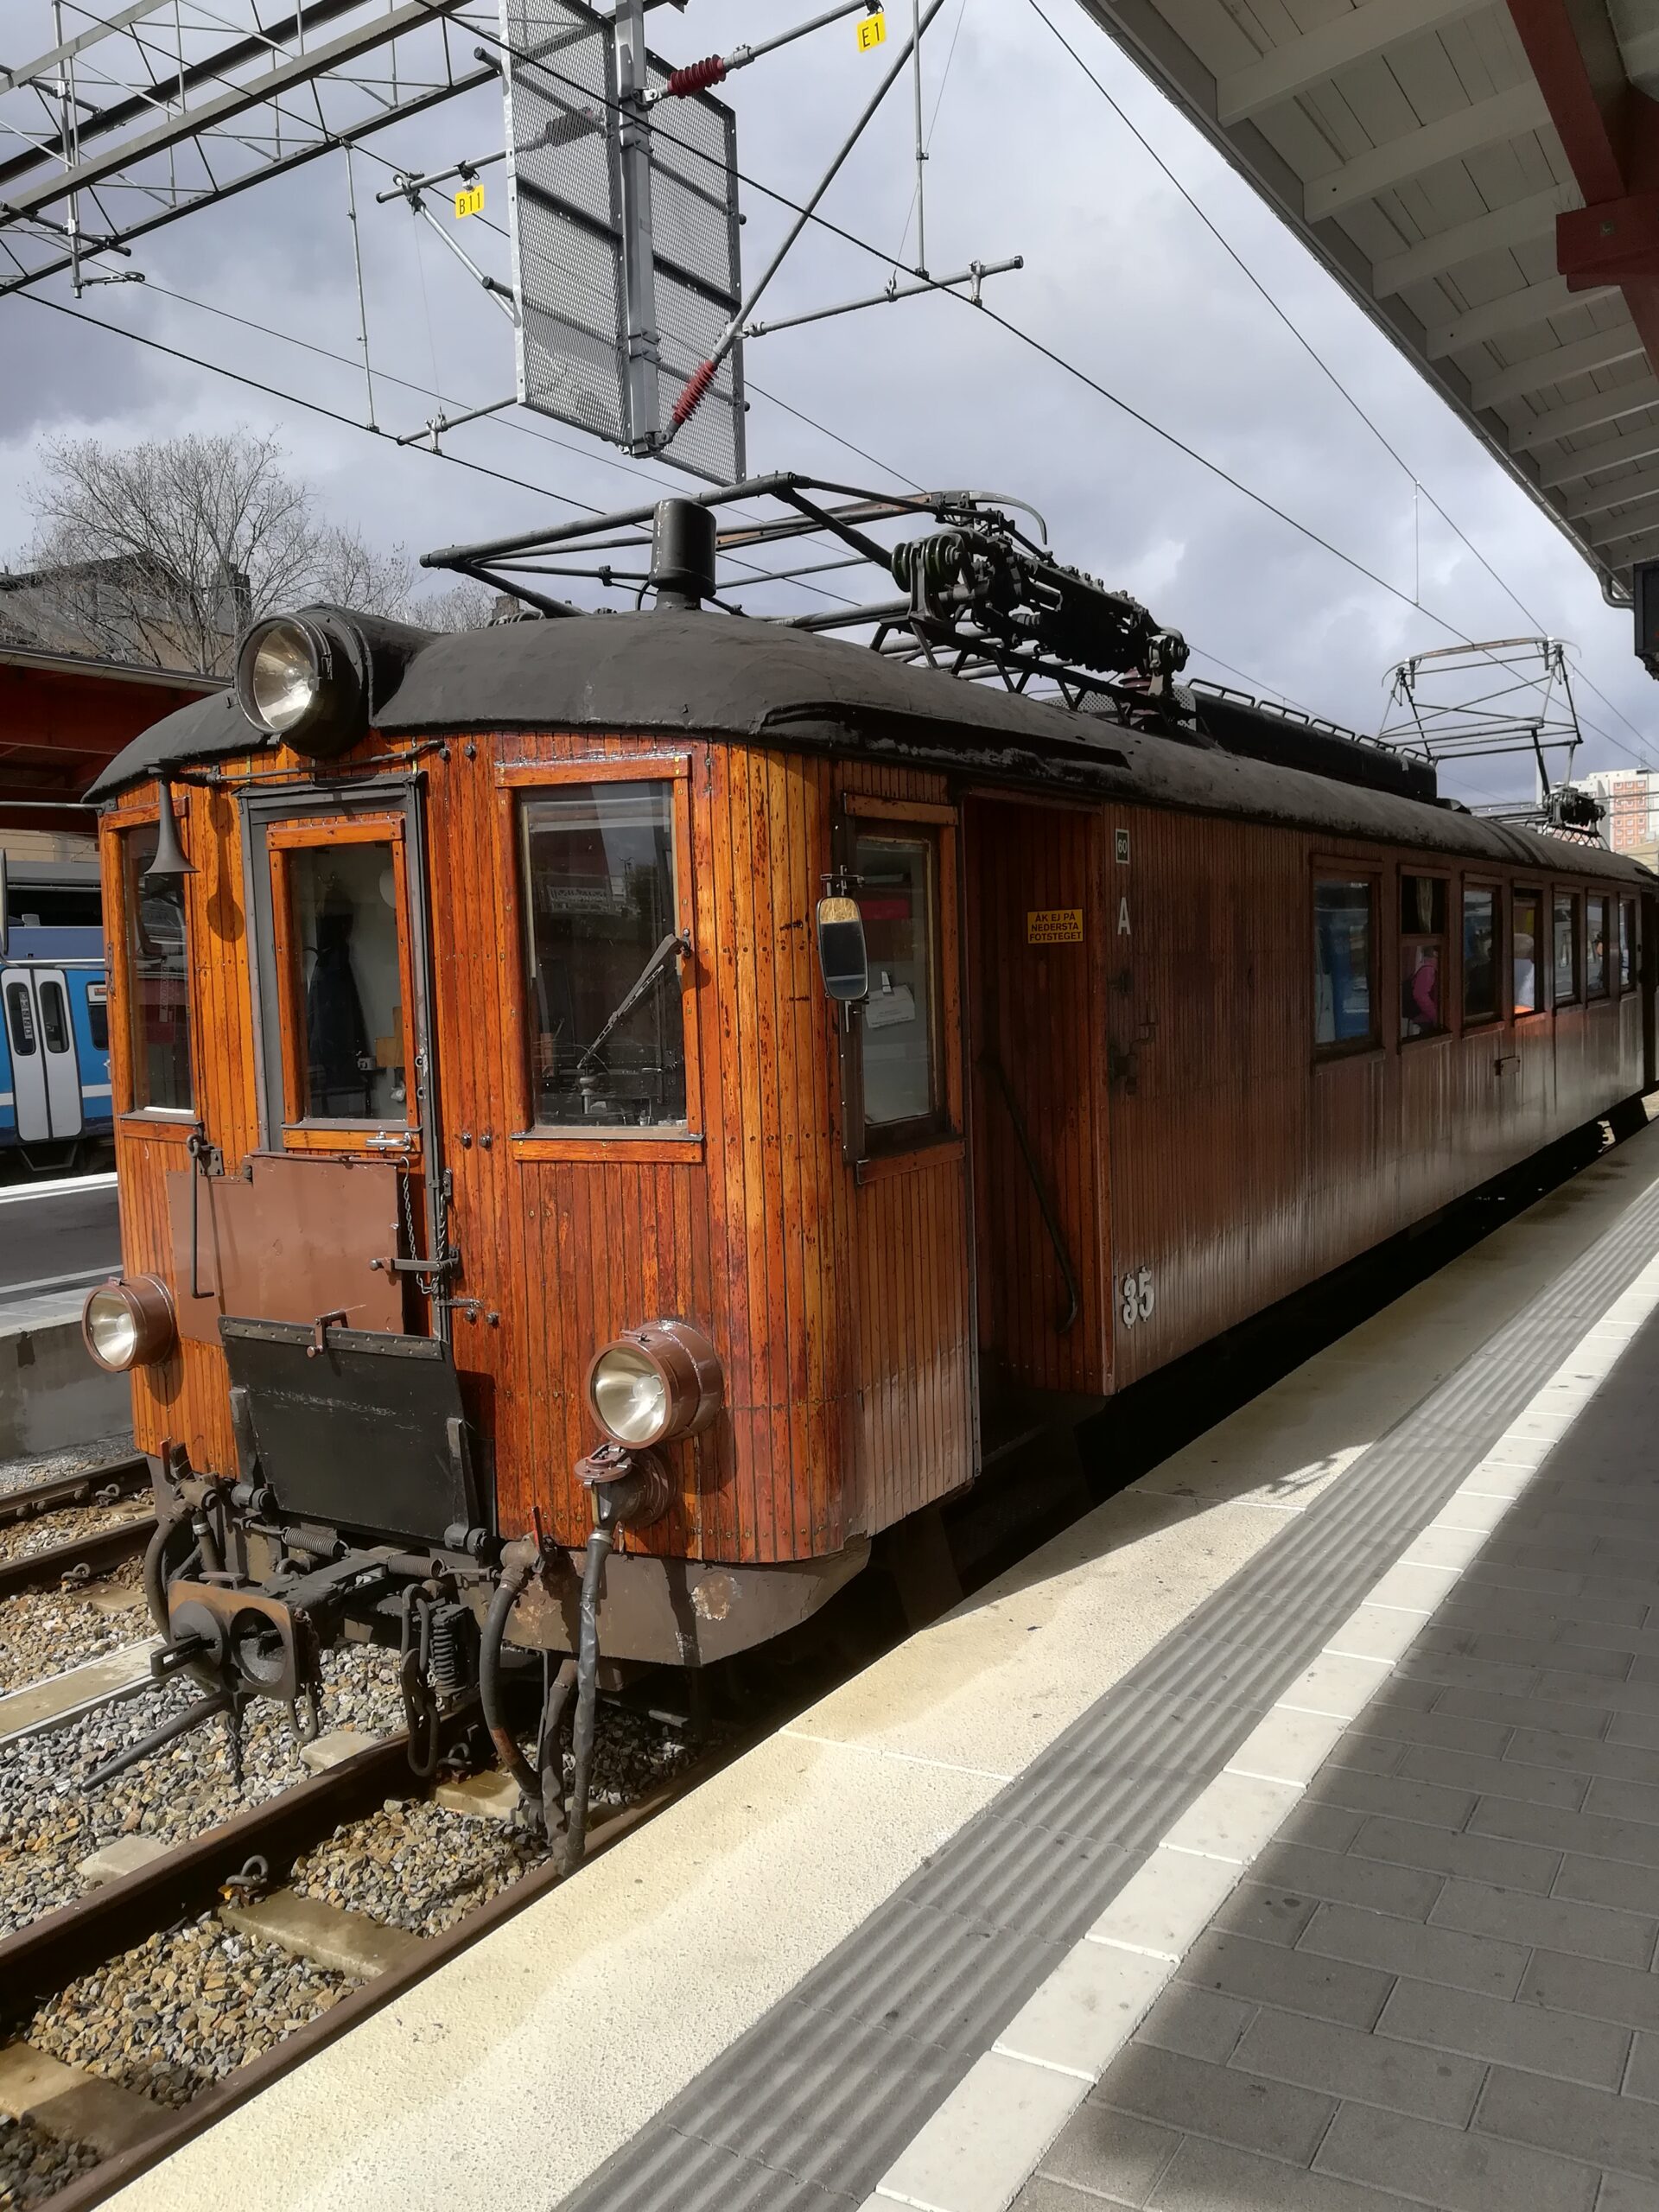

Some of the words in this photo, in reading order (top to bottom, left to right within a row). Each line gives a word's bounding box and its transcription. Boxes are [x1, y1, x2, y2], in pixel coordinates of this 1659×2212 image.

[861, 22, 880, 48] E1
[459, 192, 480, 215] B11
[1117, 839, 1128, 854] 60
[1064, 911, 1076, 920] PÅ
[1117, 897, 1132, 935] A
[1031, 922, 1079, 931] NEDERSTA
[1029, 931, 1082, 942] FOTSTEGET
